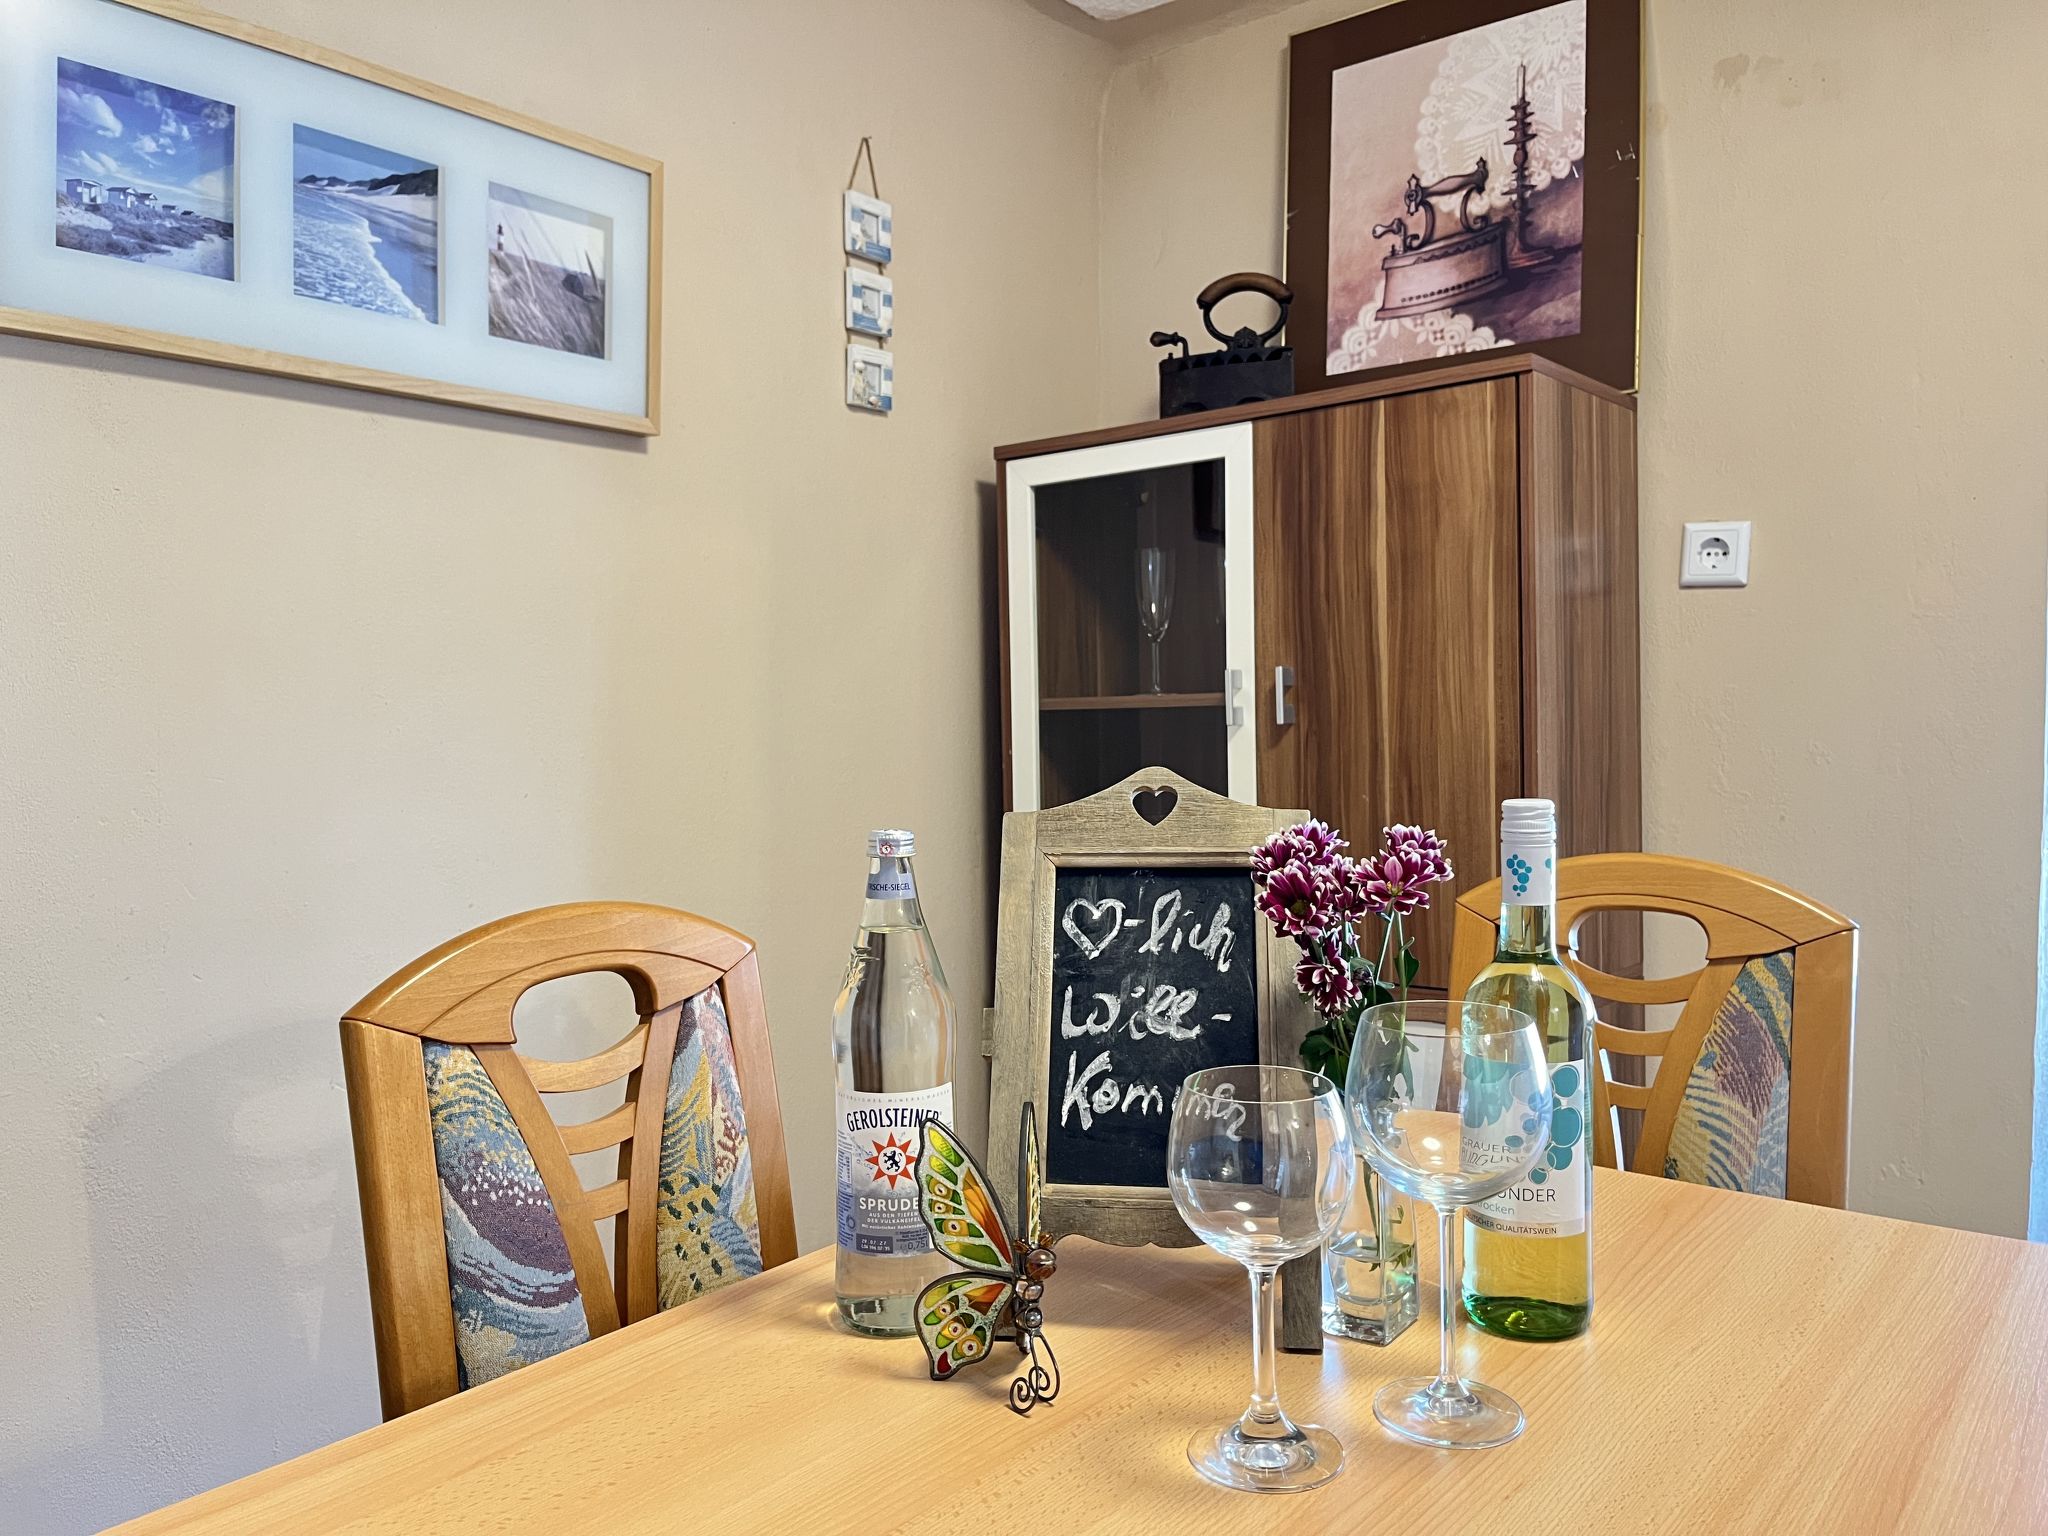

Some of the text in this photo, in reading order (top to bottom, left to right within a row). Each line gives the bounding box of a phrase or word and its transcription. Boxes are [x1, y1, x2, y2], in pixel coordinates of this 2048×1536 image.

[846, 1108, 940, 1132] GEROLSTEINER
[1461, 1136, 1512, 1154] GRAUER
[859, 1197, 920, 1212] SPRUDE
